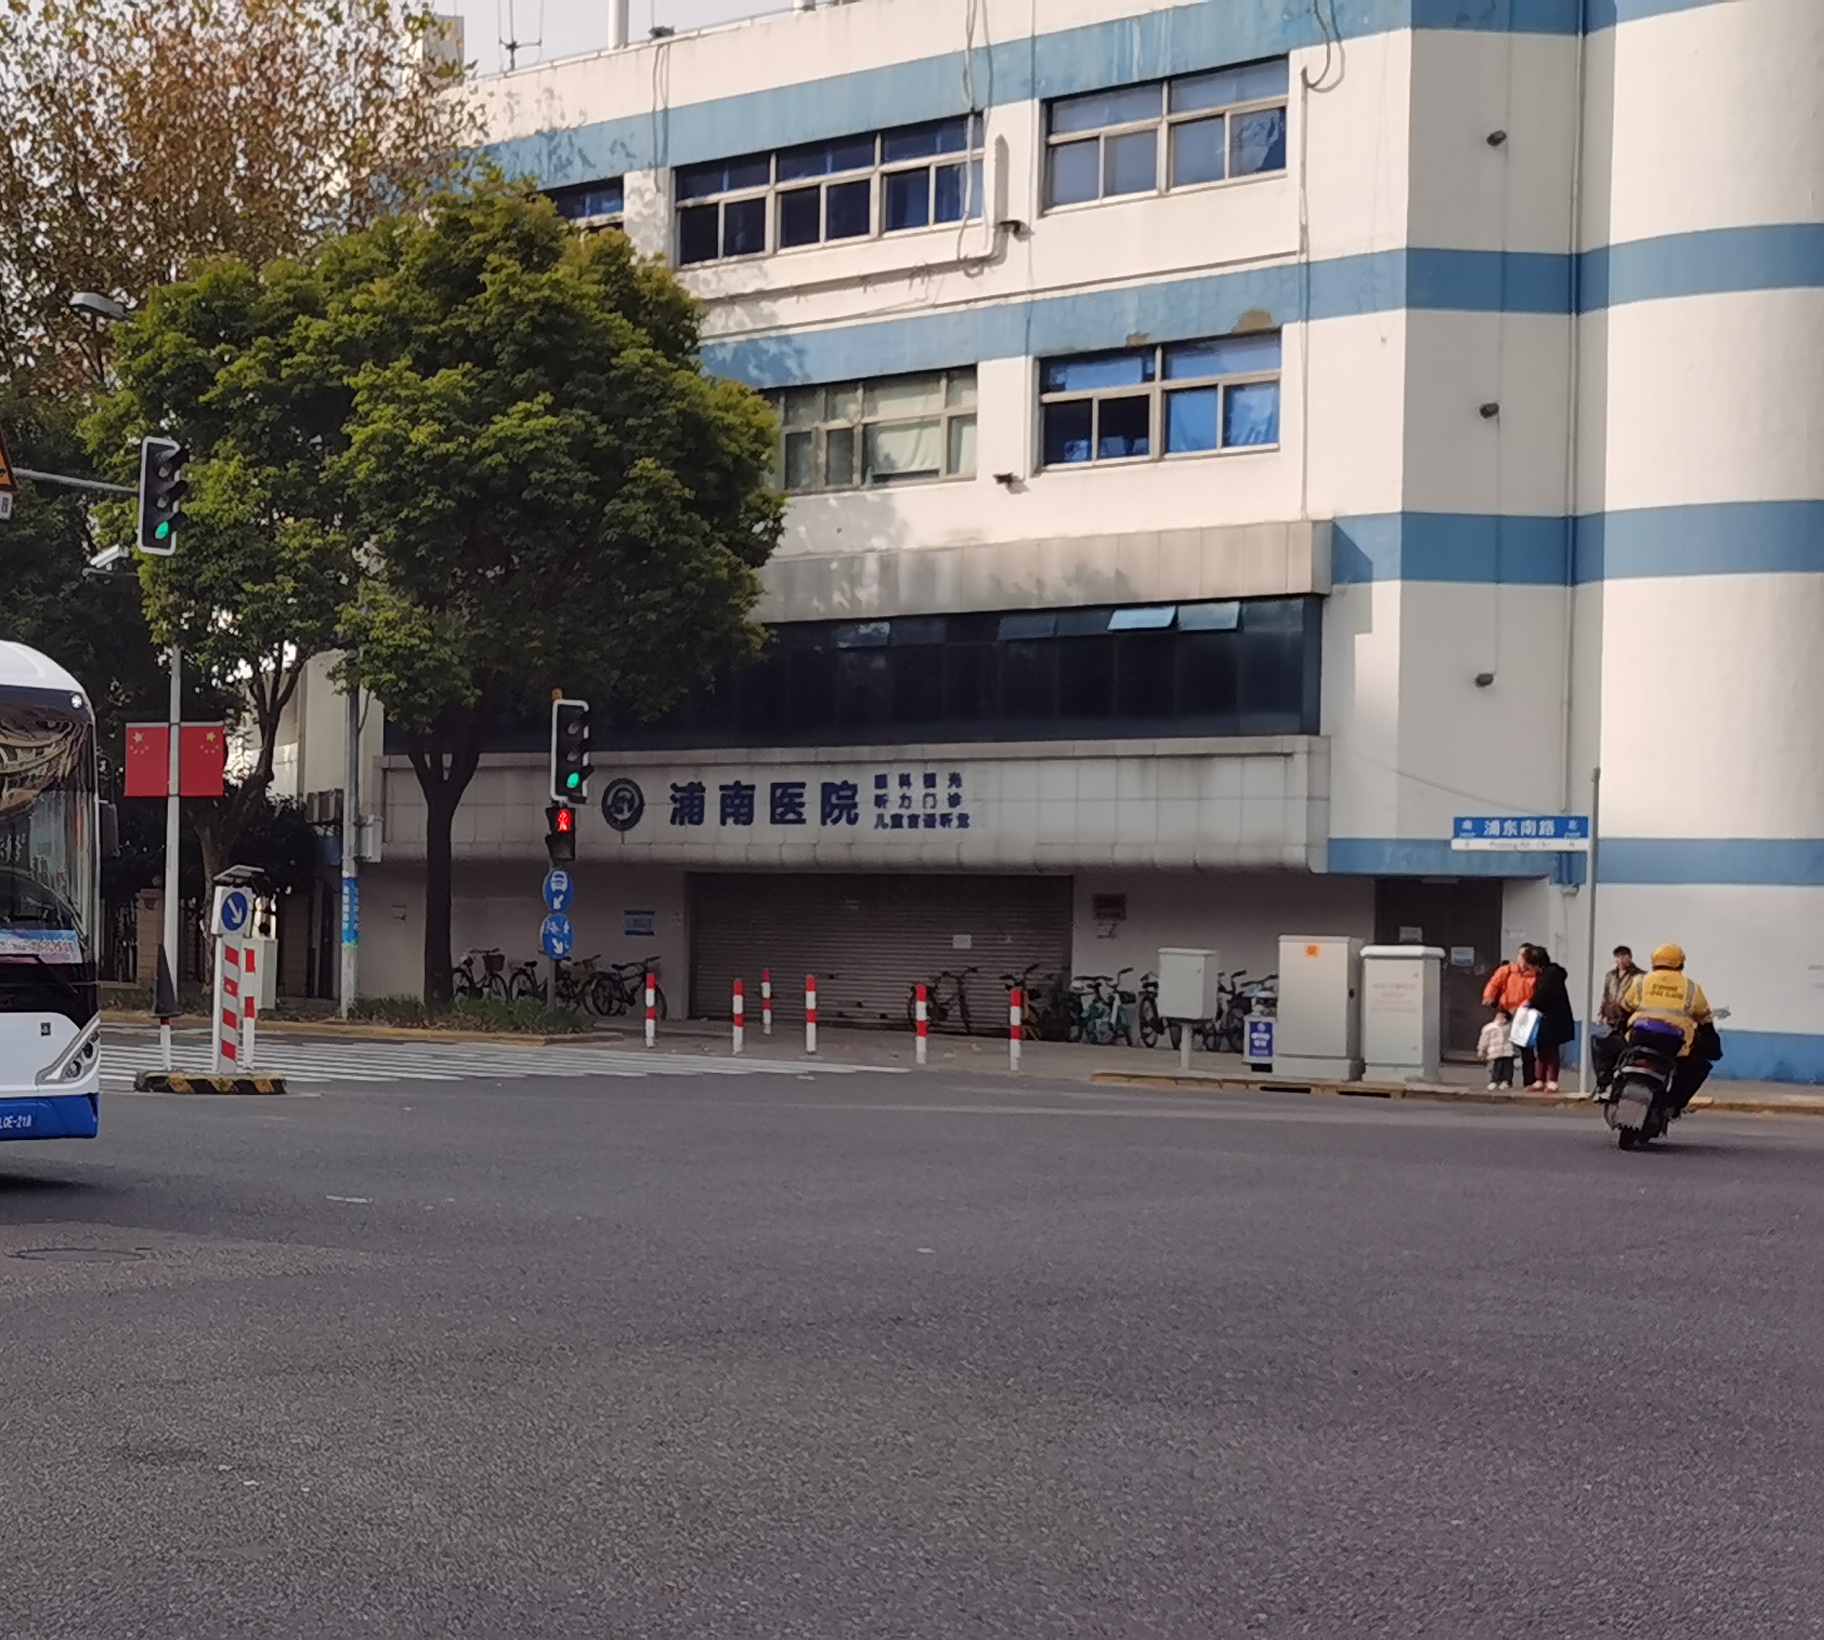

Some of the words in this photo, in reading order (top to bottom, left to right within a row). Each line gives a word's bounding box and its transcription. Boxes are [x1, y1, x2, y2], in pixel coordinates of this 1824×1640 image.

[670, 780, 859, 827] 浦南医院
[1483, 819, 1555, 836] 浦东南路
